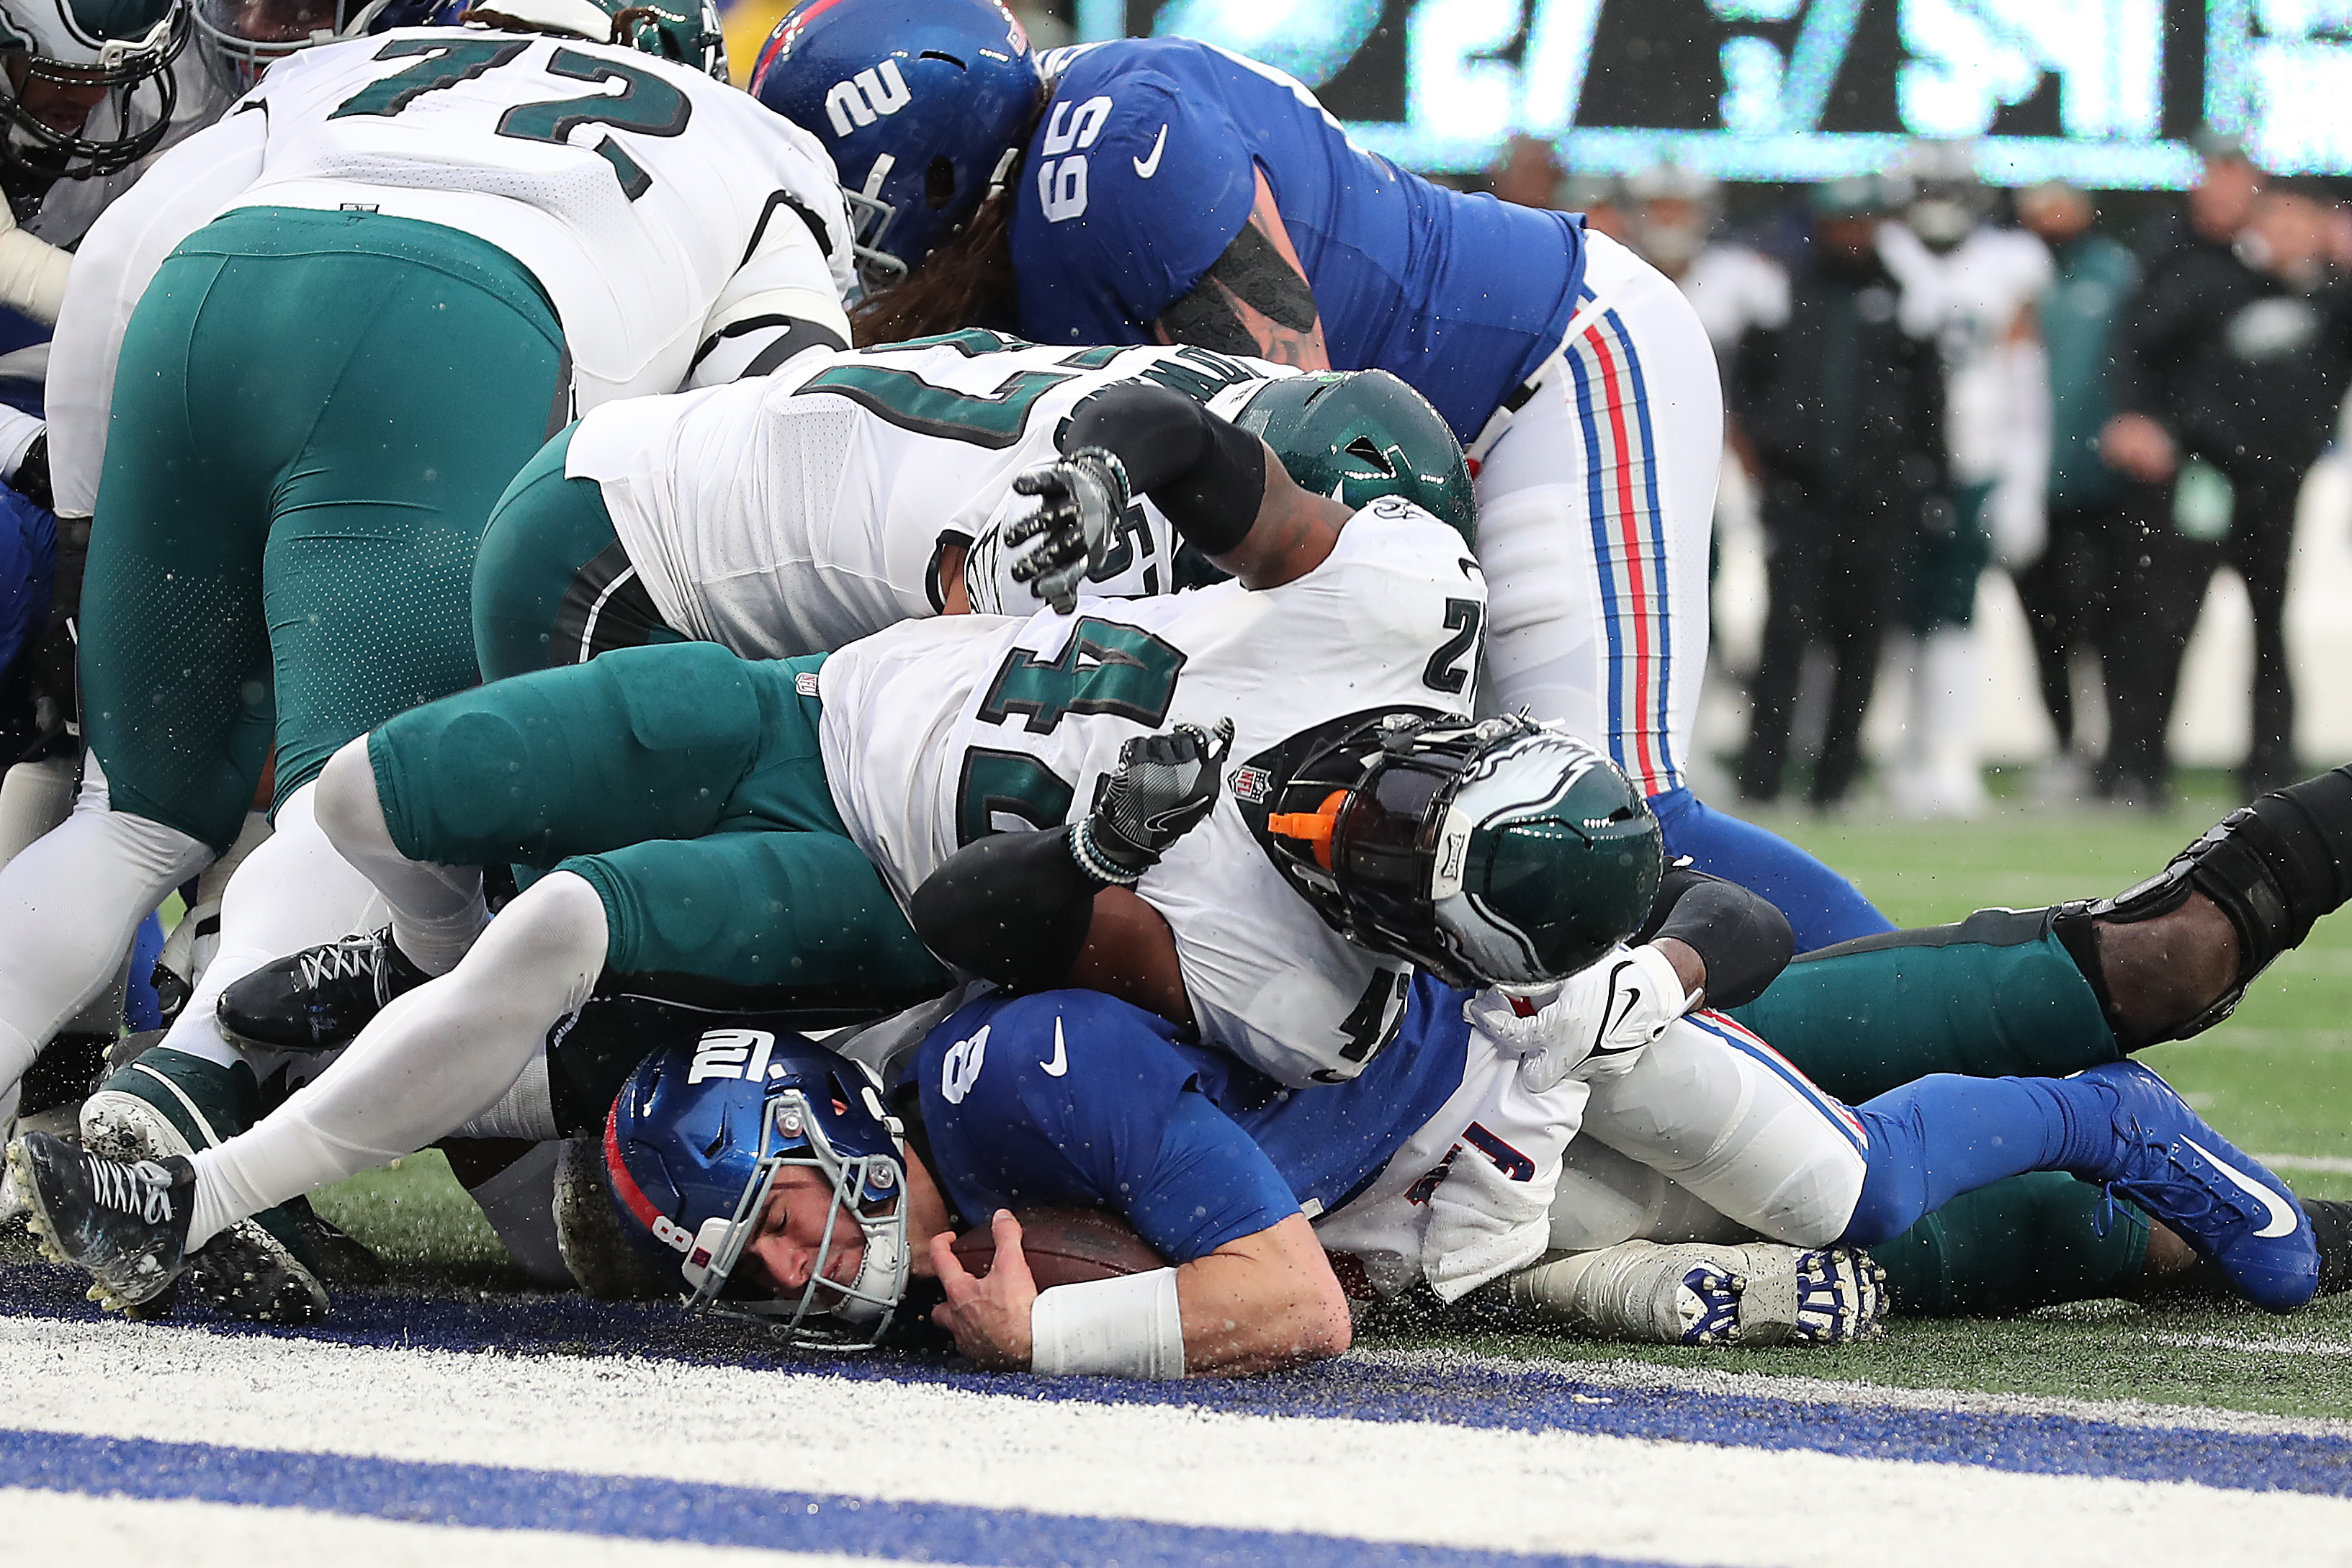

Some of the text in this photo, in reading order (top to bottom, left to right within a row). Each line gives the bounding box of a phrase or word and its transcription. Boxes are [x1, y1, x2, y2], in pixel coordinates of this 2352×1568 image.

[327, 39, 693, 203] 72
[1037, 95, 1115, 223] 65
[1086, 503, 1159, 597] 5
[1422, 597, 1486, 703] 2
[1237, 770, 1254, 794] NFL
[942, 1024, 992, 1104] 8
[652, 1215, 694, 1253] 8
